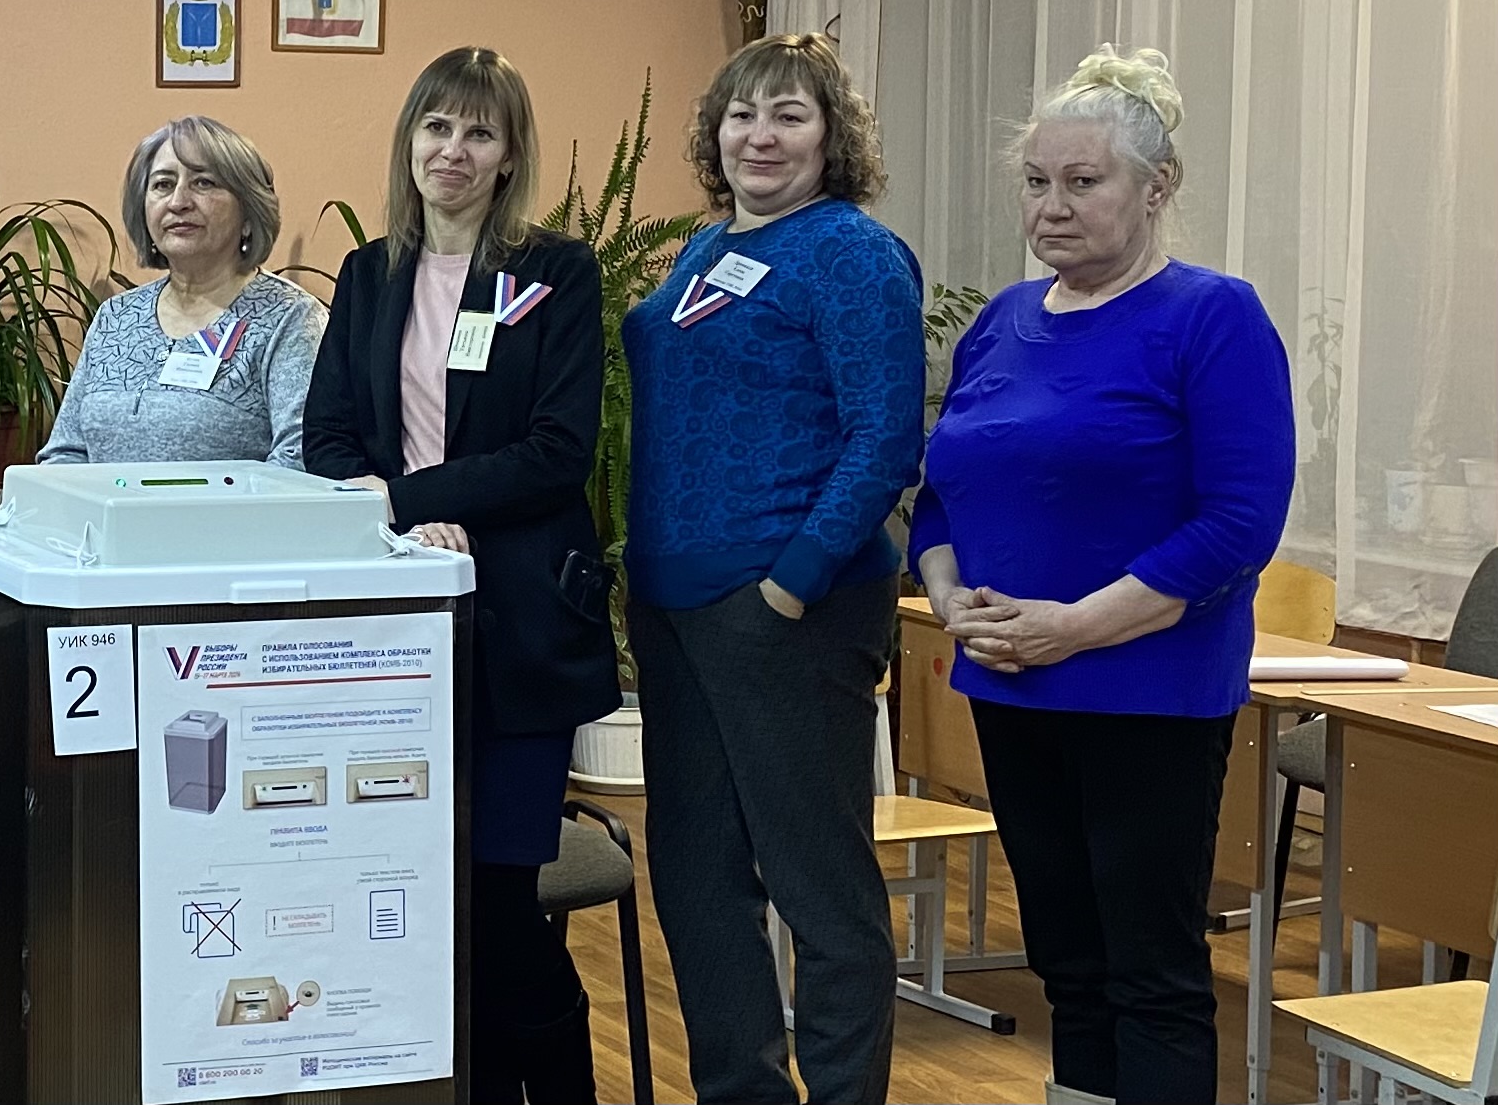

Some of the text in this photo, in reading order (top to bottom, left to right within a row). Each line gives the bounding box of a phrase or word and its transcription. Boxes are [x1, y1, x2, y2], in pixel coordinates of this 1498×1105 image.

[58, 633, 116, 648] УИК 946
[262, 640, 353, 652] ПРАВИЛА ГОЛОСОВАНИЯ
[204, 644, 238, 652] ВЫБОРЫ
[200, 653, 248, 662] ПРЕЗИДЕНТА
[262, 648, 432, 663] С ИСПОЛЬЗОВАНИЕМ КОМПЛЕКСА ОБРАБОТКИ
[196, 663, 228, 671] РОССИИ
[262, 663, 326, 674] ИЗБИРАТЕЛЬНЫХ
[328, 660, 377, 671] БЮЛЛЕТЕНЕЙ
[65, 665, 100, 719] 2
